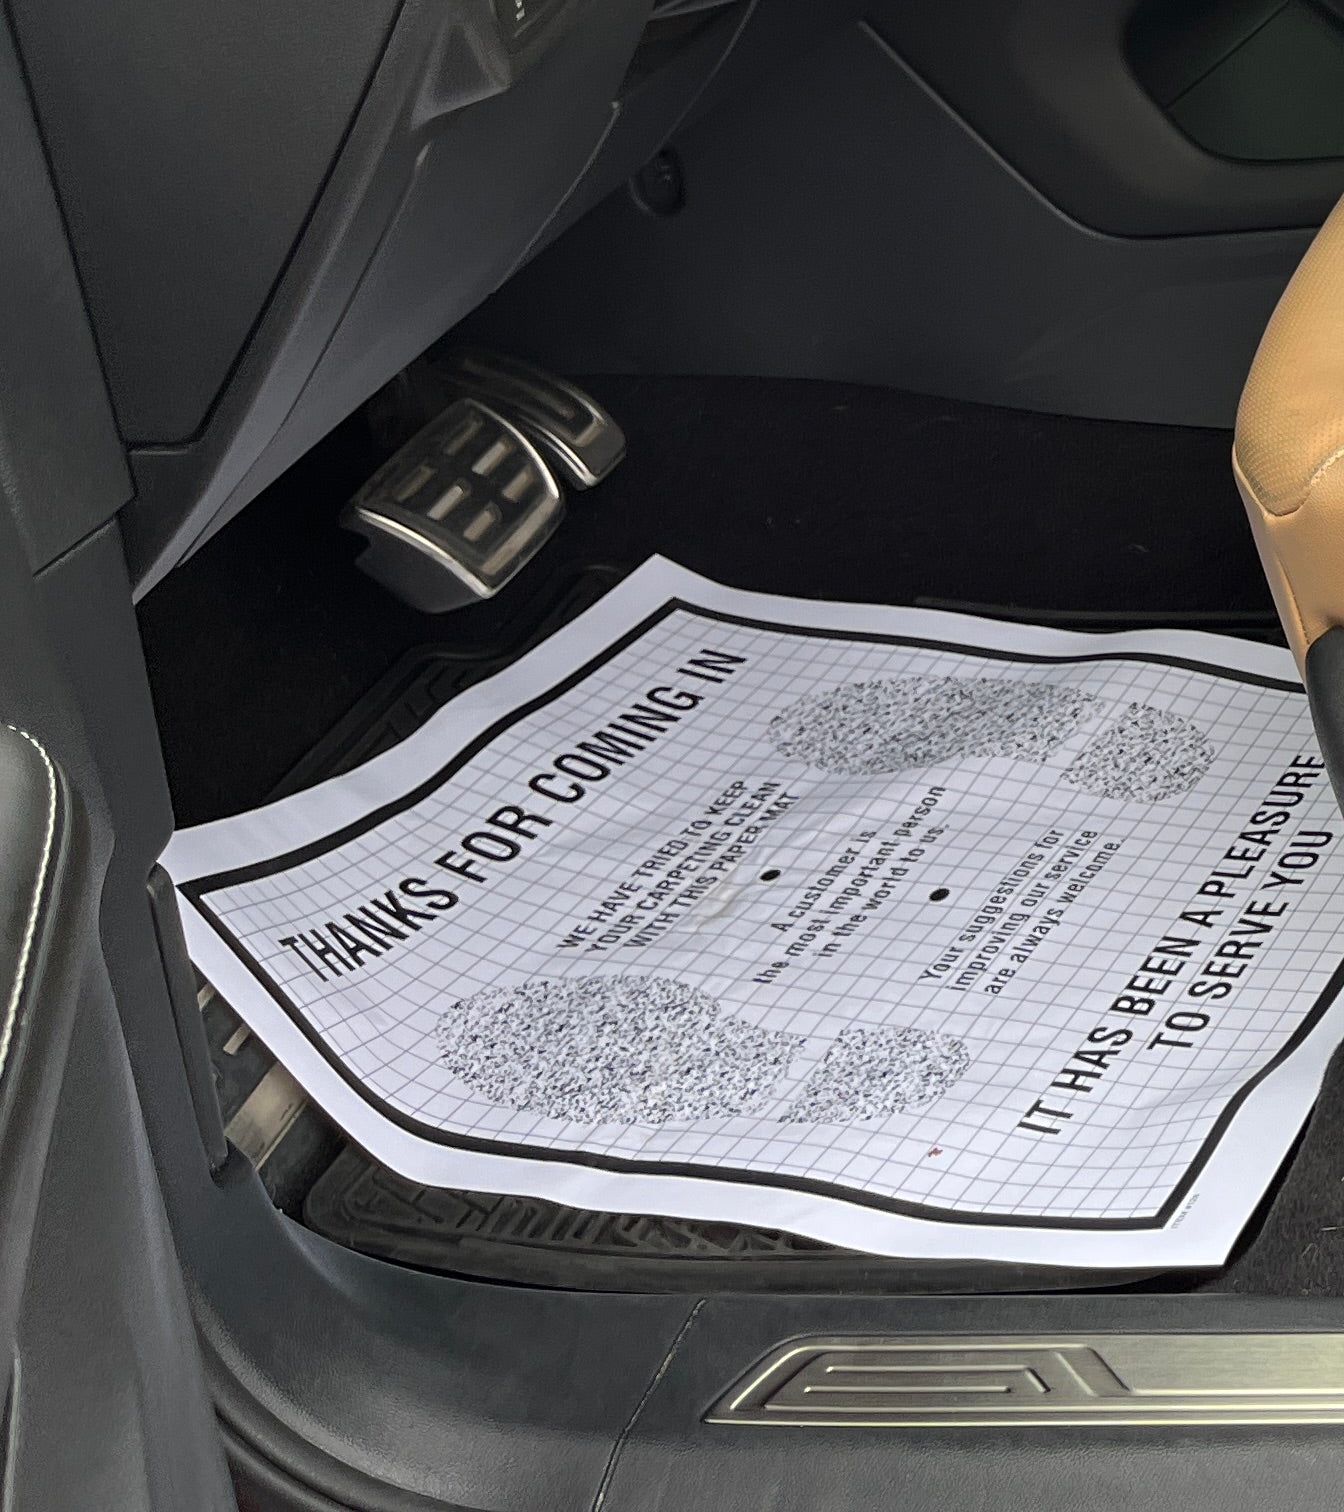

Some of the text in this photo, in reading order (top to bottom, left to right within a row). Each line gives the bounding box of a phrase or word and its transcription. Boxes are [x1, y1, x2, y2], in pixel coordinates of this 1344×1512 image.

[278, 649, 747, 982] THANKS FOR COMING IN
[557, 780, 748, 950] WE HAVE TRIED TO KEEP
[584, 781, 781, 953] YOUR CARPETING CLEAN
[623, 791, 800, 949] WITH THIS PAPER MAT
[752, 786, 946, 984] the most important person
[771, 831, 877, 932] A customer is
[812, 824, 950, 957] in the world to us.
[918, 830, 1065, 981] Your suggestions for
[946, 831, 1098, 991] improving our service
[984, 839, 1125, 995] are always welcome.
[1016, 755, 1326, 1135] IT HAS BEEN A PLEASURE
[1146, 830, 1334, 1050] TO SERVE YOU
